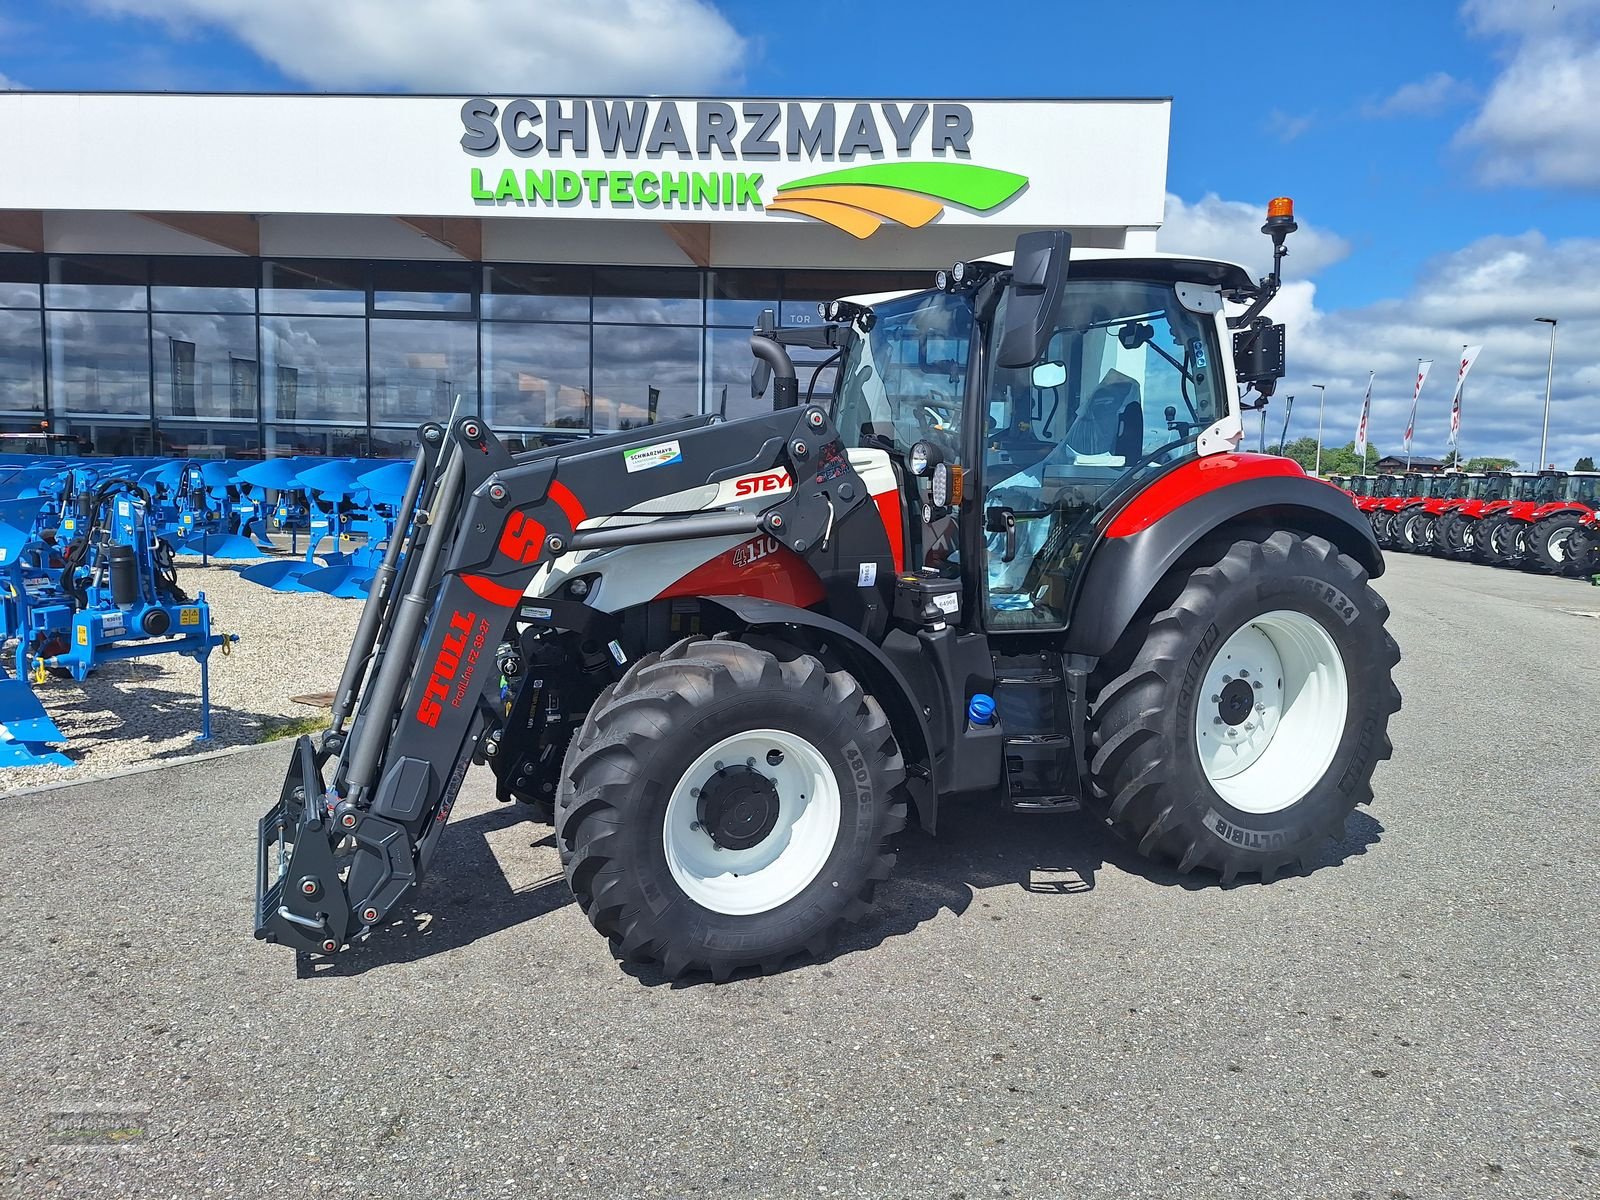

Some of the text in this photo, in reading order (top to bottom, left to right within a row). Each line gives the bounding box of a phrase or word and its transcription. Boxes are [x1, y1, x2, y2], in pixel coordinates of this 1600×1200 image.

[460, 98, 974, 160] SCHWARZMAYR
[470, 167, 764, 208] LANDTECHNIK
[790, 314, 811, 323] TOR
[732, 537, 780, 568] 4110
[416, 610, 477, 729] STOLL
[1215, 818, 1298, 849] ULTIBIB
